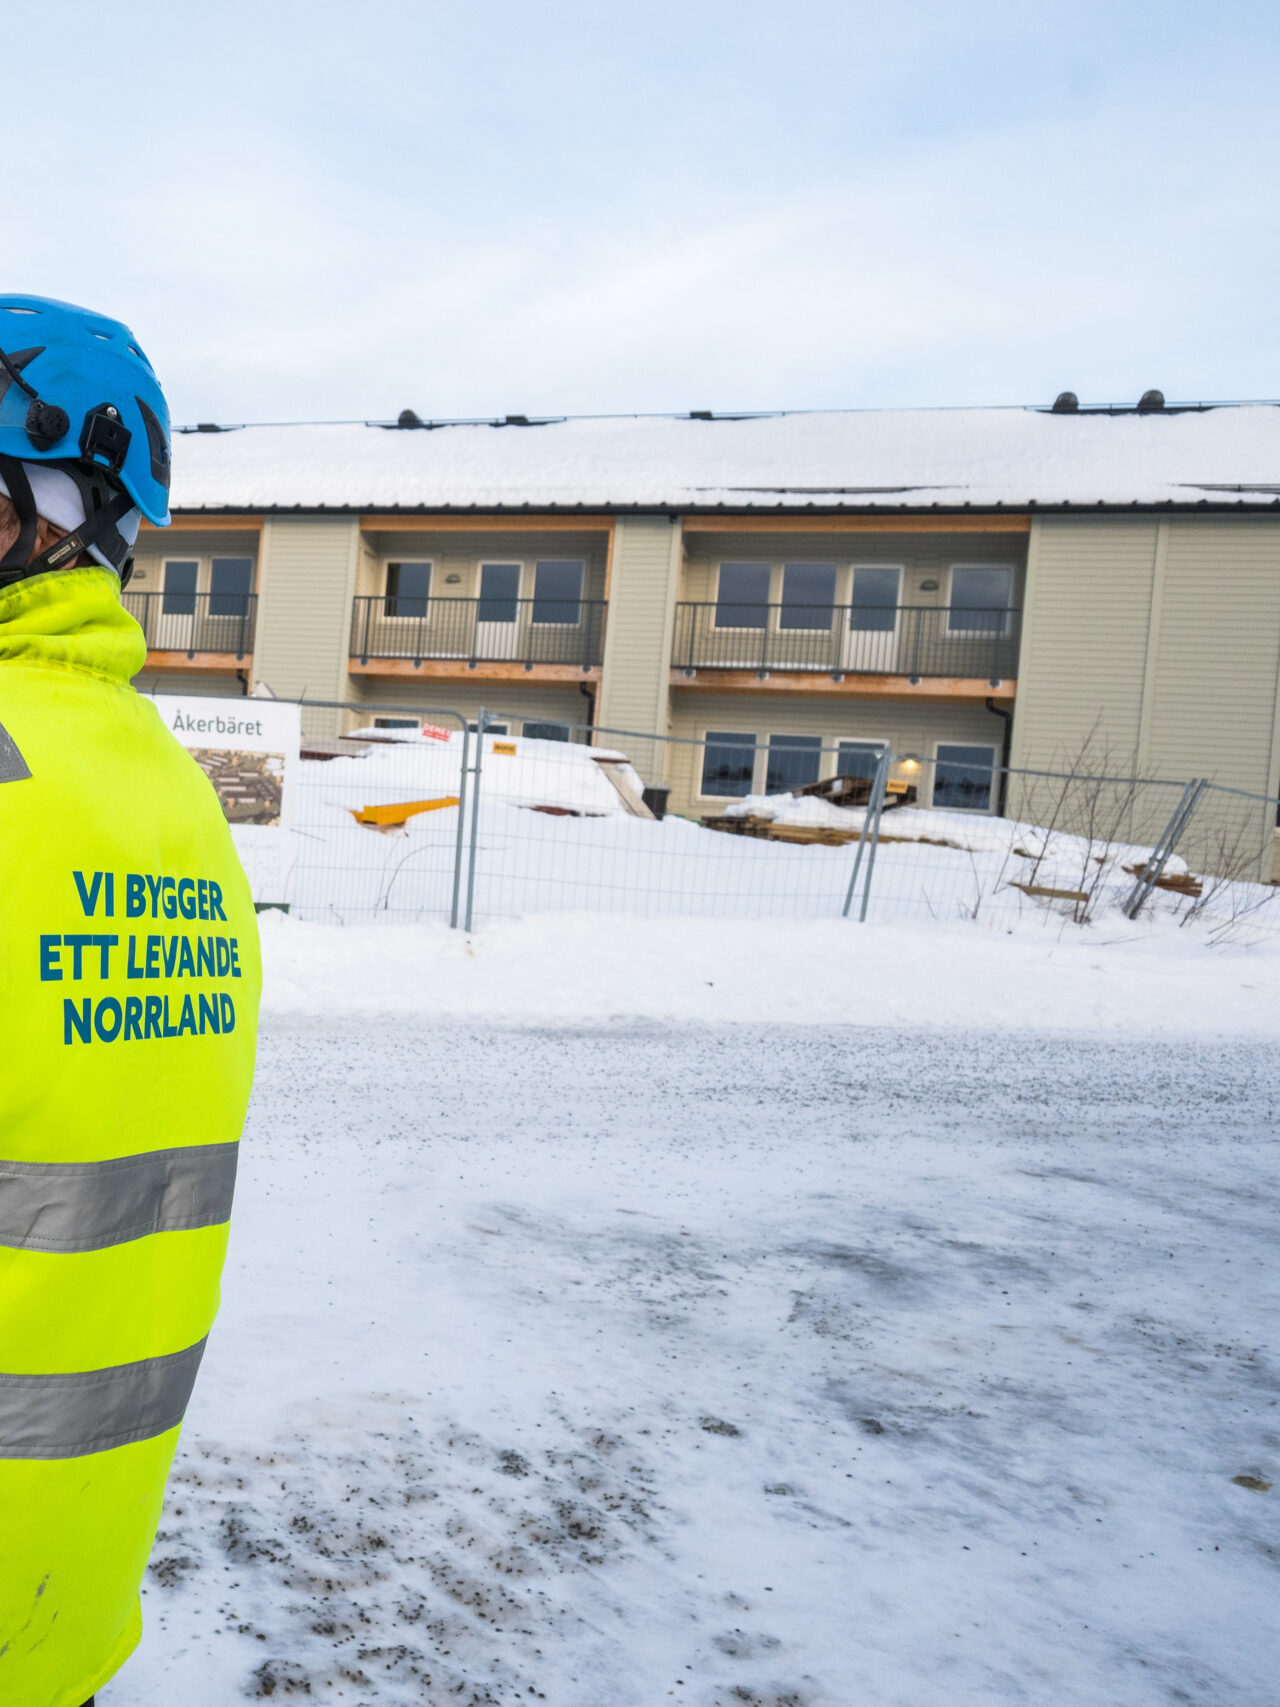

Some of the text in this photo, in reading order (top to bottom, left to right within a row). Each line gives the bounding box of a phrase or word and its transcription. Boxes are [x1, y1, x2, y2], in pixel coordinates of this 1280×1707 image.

[172, 710, 263, 736] Åkerbäret
[72, 870, 228, 922] VI BYGGER
[40, 934, 242, 981] ETT LEVANDE
[64, 993, 236, 1045] NORRLAND
